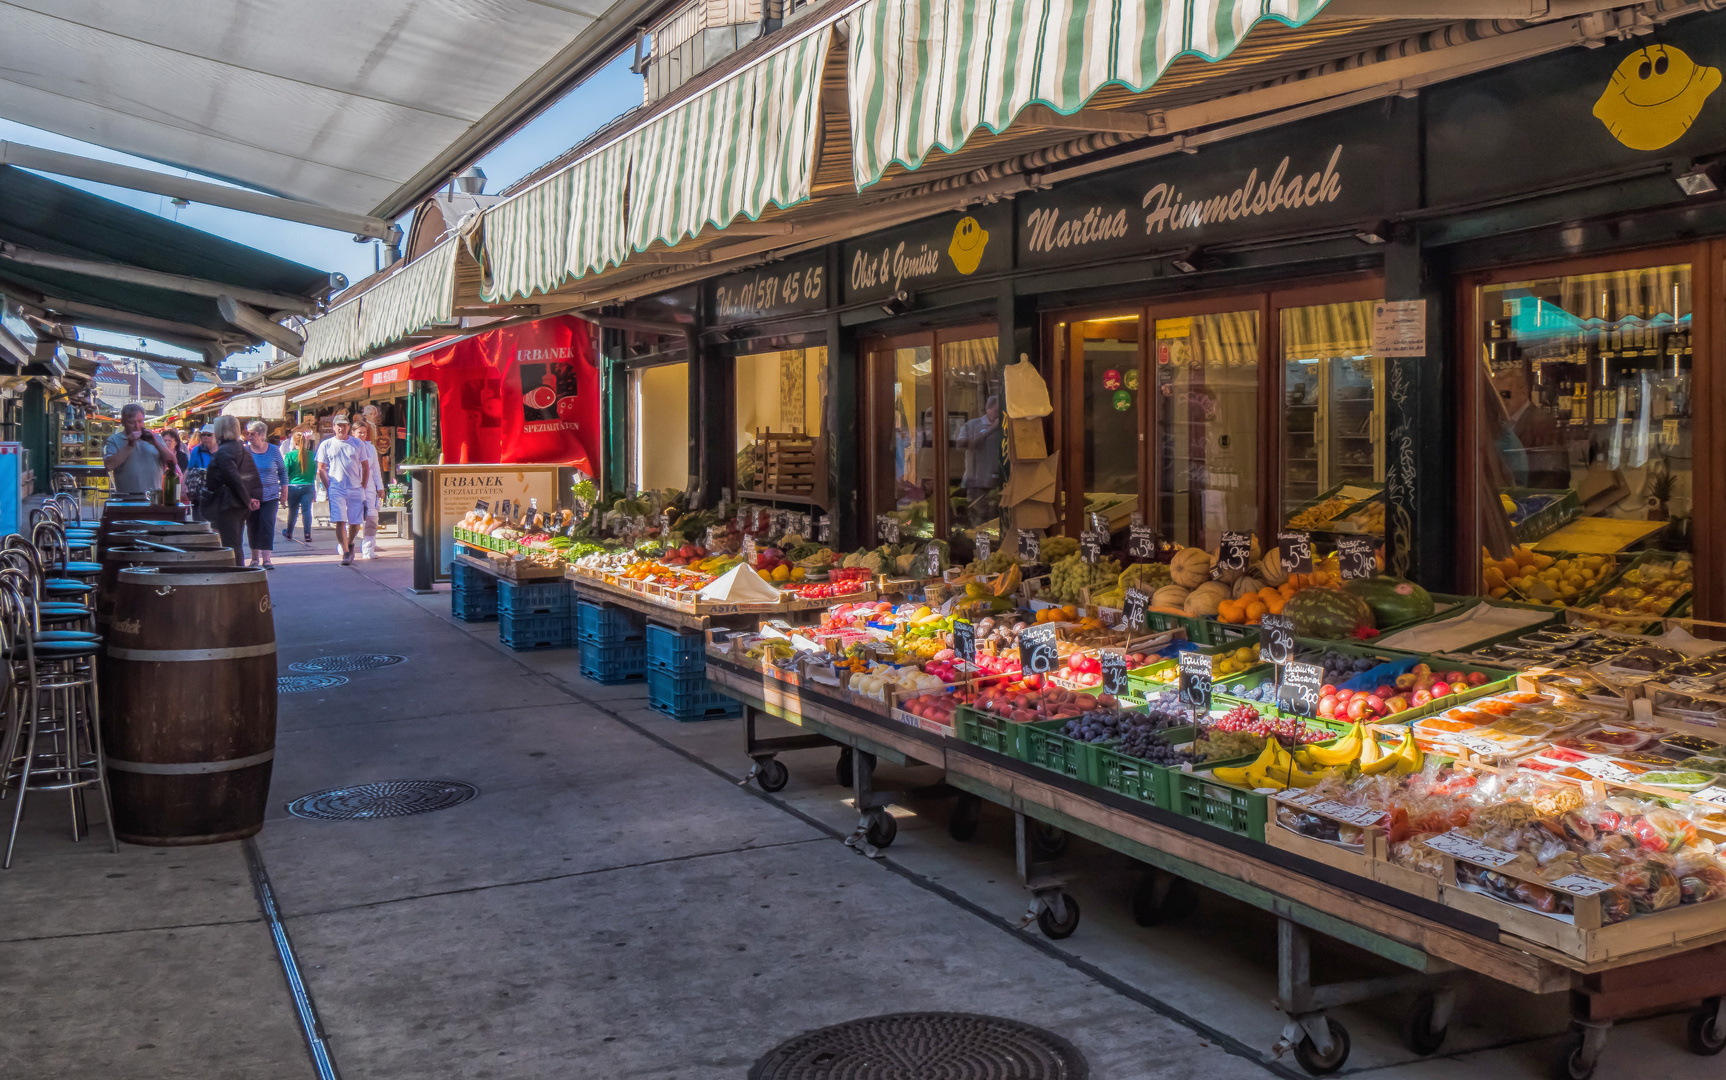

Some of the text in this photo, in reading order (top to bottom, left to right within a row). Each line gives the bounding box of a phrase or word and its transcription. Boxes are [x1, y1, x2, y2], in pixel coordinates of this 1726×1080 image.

[1027, 144, 1342, 252] Martina Himmelsbach
[852, 241, 939, 291] Obst & Gemüse
[782, 271, 800, 304] 45
[803, 266, 823, 299] 65
[517, 347, 575, 362] URBANEK
[523, 421, 579, 433] SPEZIALITÄTEN
[444, 476, 503, 486] URBANEK
[444, 487, 503, 495] SPEZIALITÄTEN
[807, 600, 832, 608] ASTA
[1286, 662, 1318, 676] Chiquita
[901, 714, 918, 728] ASTA
